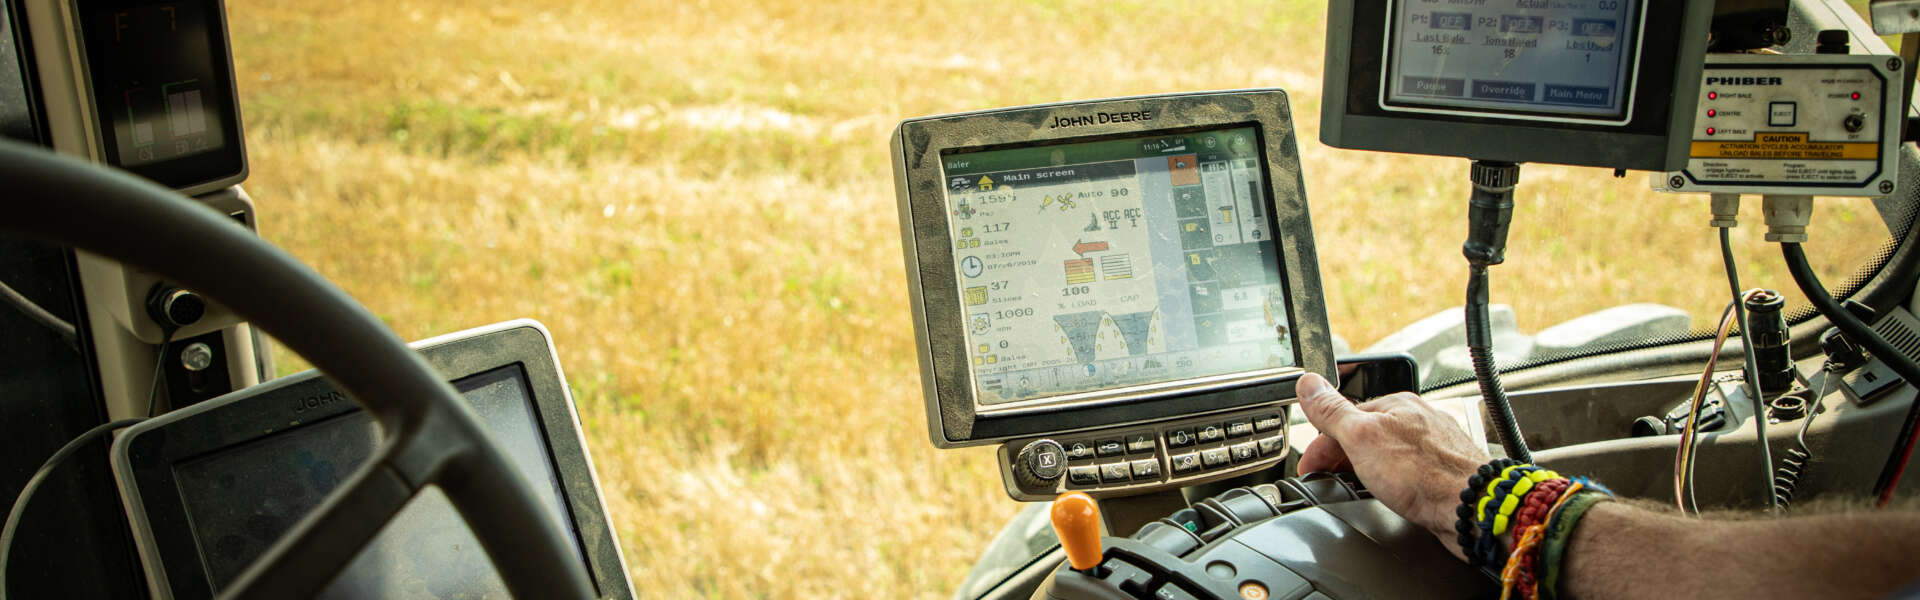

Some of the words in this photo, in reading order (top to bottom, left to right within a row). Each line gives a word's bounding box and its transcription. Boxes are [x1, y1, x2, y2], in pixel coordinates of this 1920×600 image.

[1706, 77, 1783, 86] PHIBER
[1481, 86, 1526, 97] Override
[1550, 88, 1573, 99] Main
[1576, 90, 1603, 101] Menu
[1050, 116, 1094, 129] JOHN
[1097, 111, 1153, 124] DEERE
[1003, 174, 1031, 182] Main
[1036, 168, 1075, 179] screen
[1078, 191, 1103, 199] Auto
[1110, 187, 1129, 198] 90
[1103, 209, 1121, 221] ACC
[1124, 207, 1142, 218] ACC
[984, 222, 1010, 234] 117
[991, 281, 1009, 291] 37
[1062, 286, 1090, 297] 100
[994, 307, 1034, 321] 1000
[1000, 339, 1009, 349] 0
